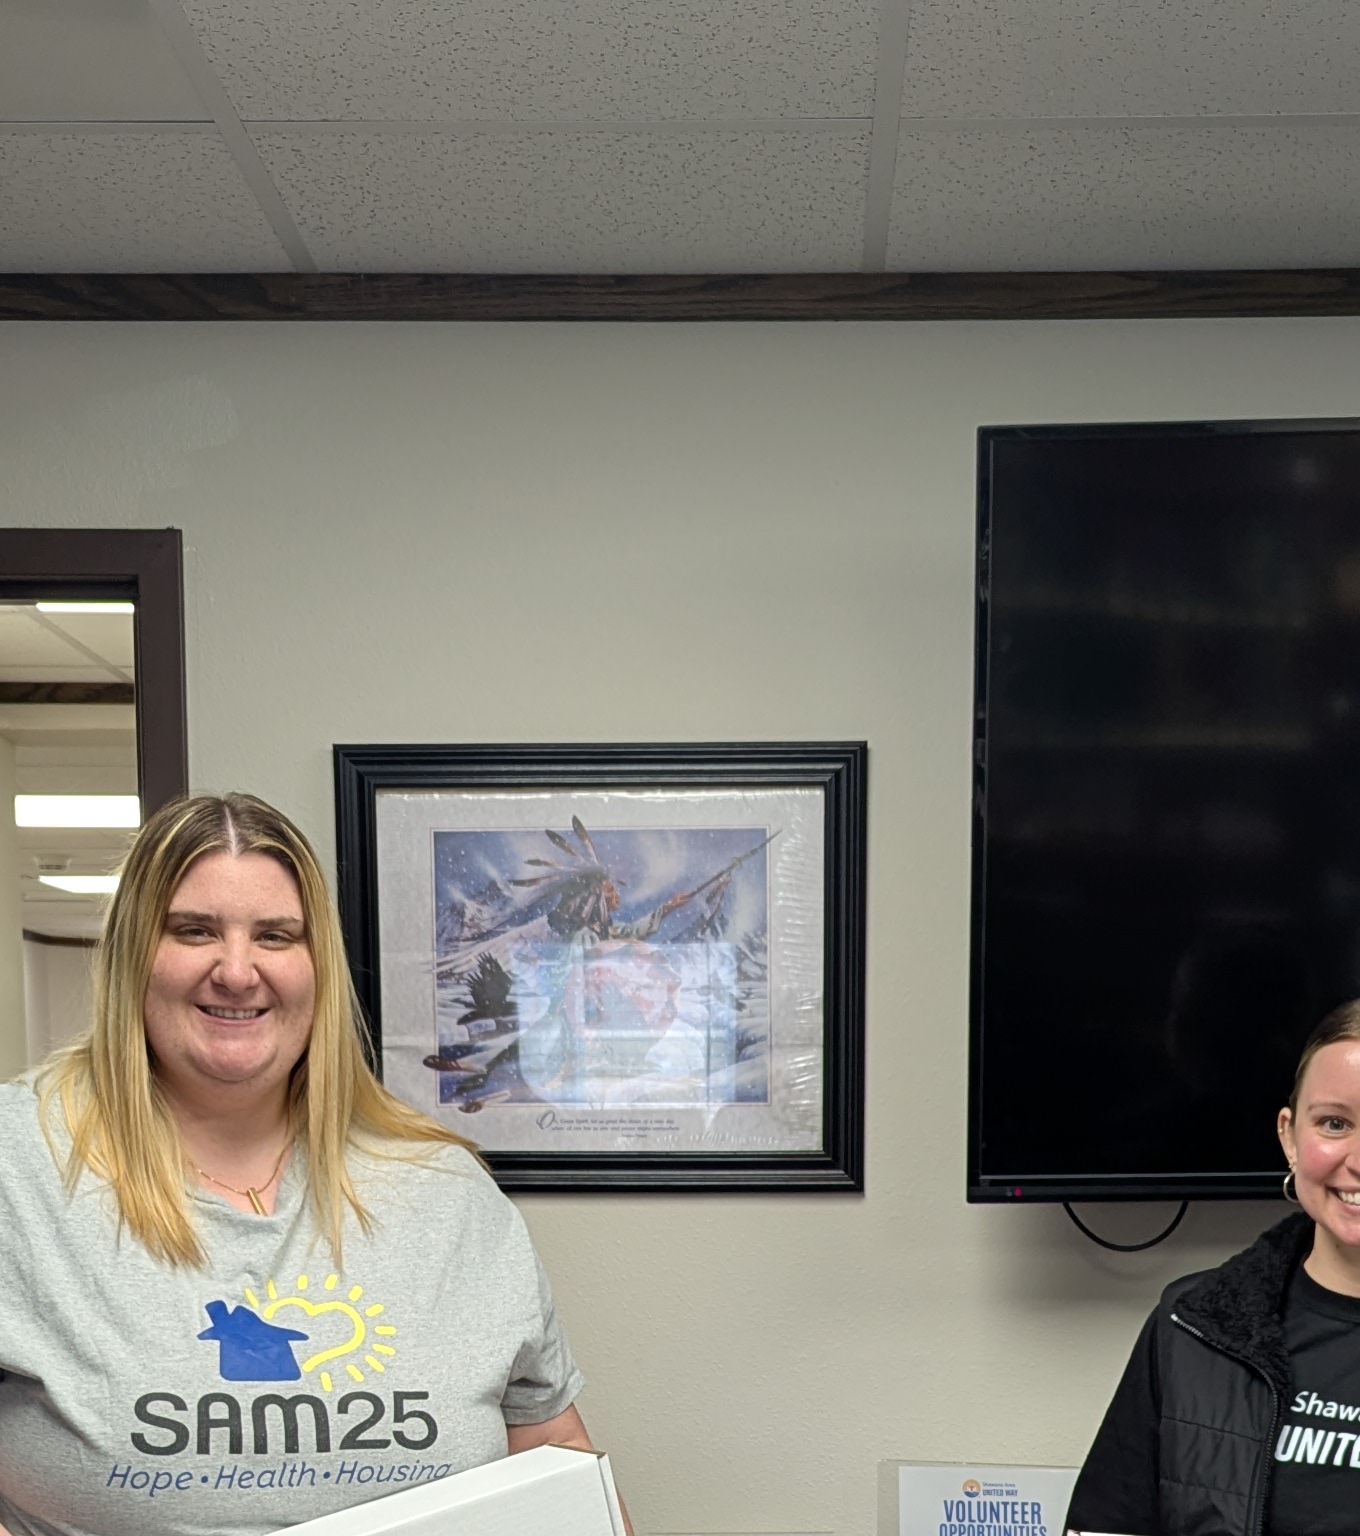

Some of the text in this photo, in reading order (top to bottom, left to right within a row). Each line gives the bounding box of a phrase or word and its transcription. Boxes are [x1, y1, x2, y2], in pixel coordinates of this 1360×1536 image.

[130, 1391, 438, 1456] SAM25
[982, 1489, 1018, 1497] UNITED WAY
[943, 1499, 1042, 1525] VOLUNTEER
